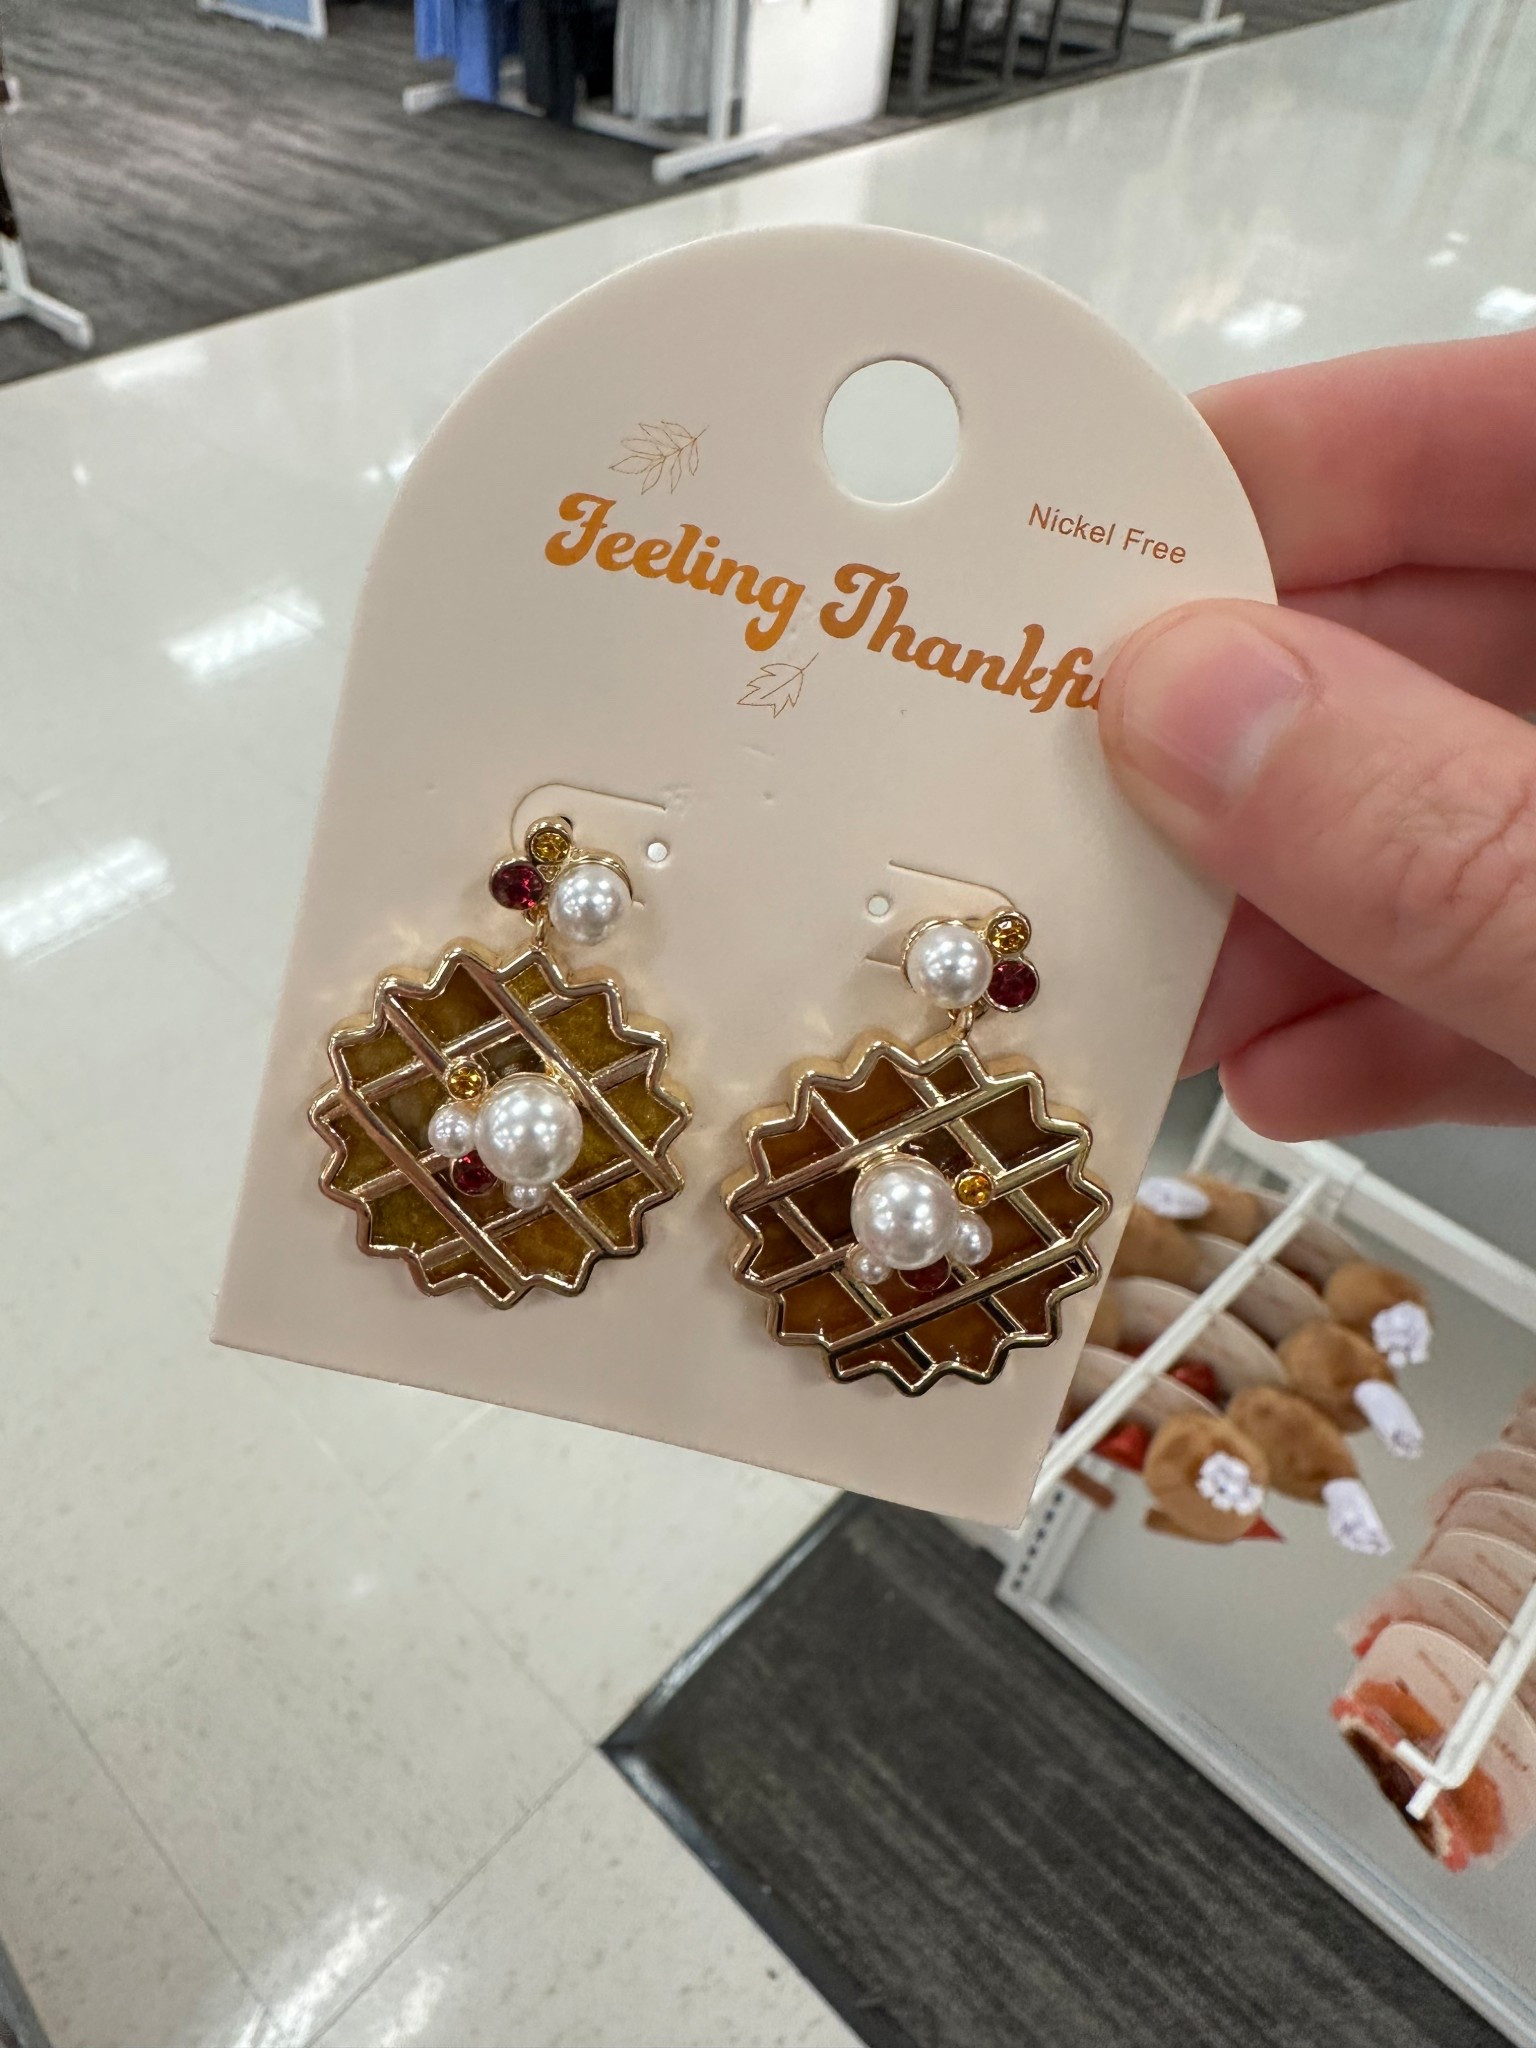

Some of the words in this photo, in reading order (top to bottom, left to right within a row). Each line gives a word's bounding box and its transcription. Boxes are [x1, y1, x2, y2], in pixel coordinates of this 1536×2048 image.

[545, 492, 806, 652] Feeling
[819, 563, 1104, 713] Thankfu
[1028, 503, 1116, 546] Nickel
[1122, 527, 1186, 564] Free
